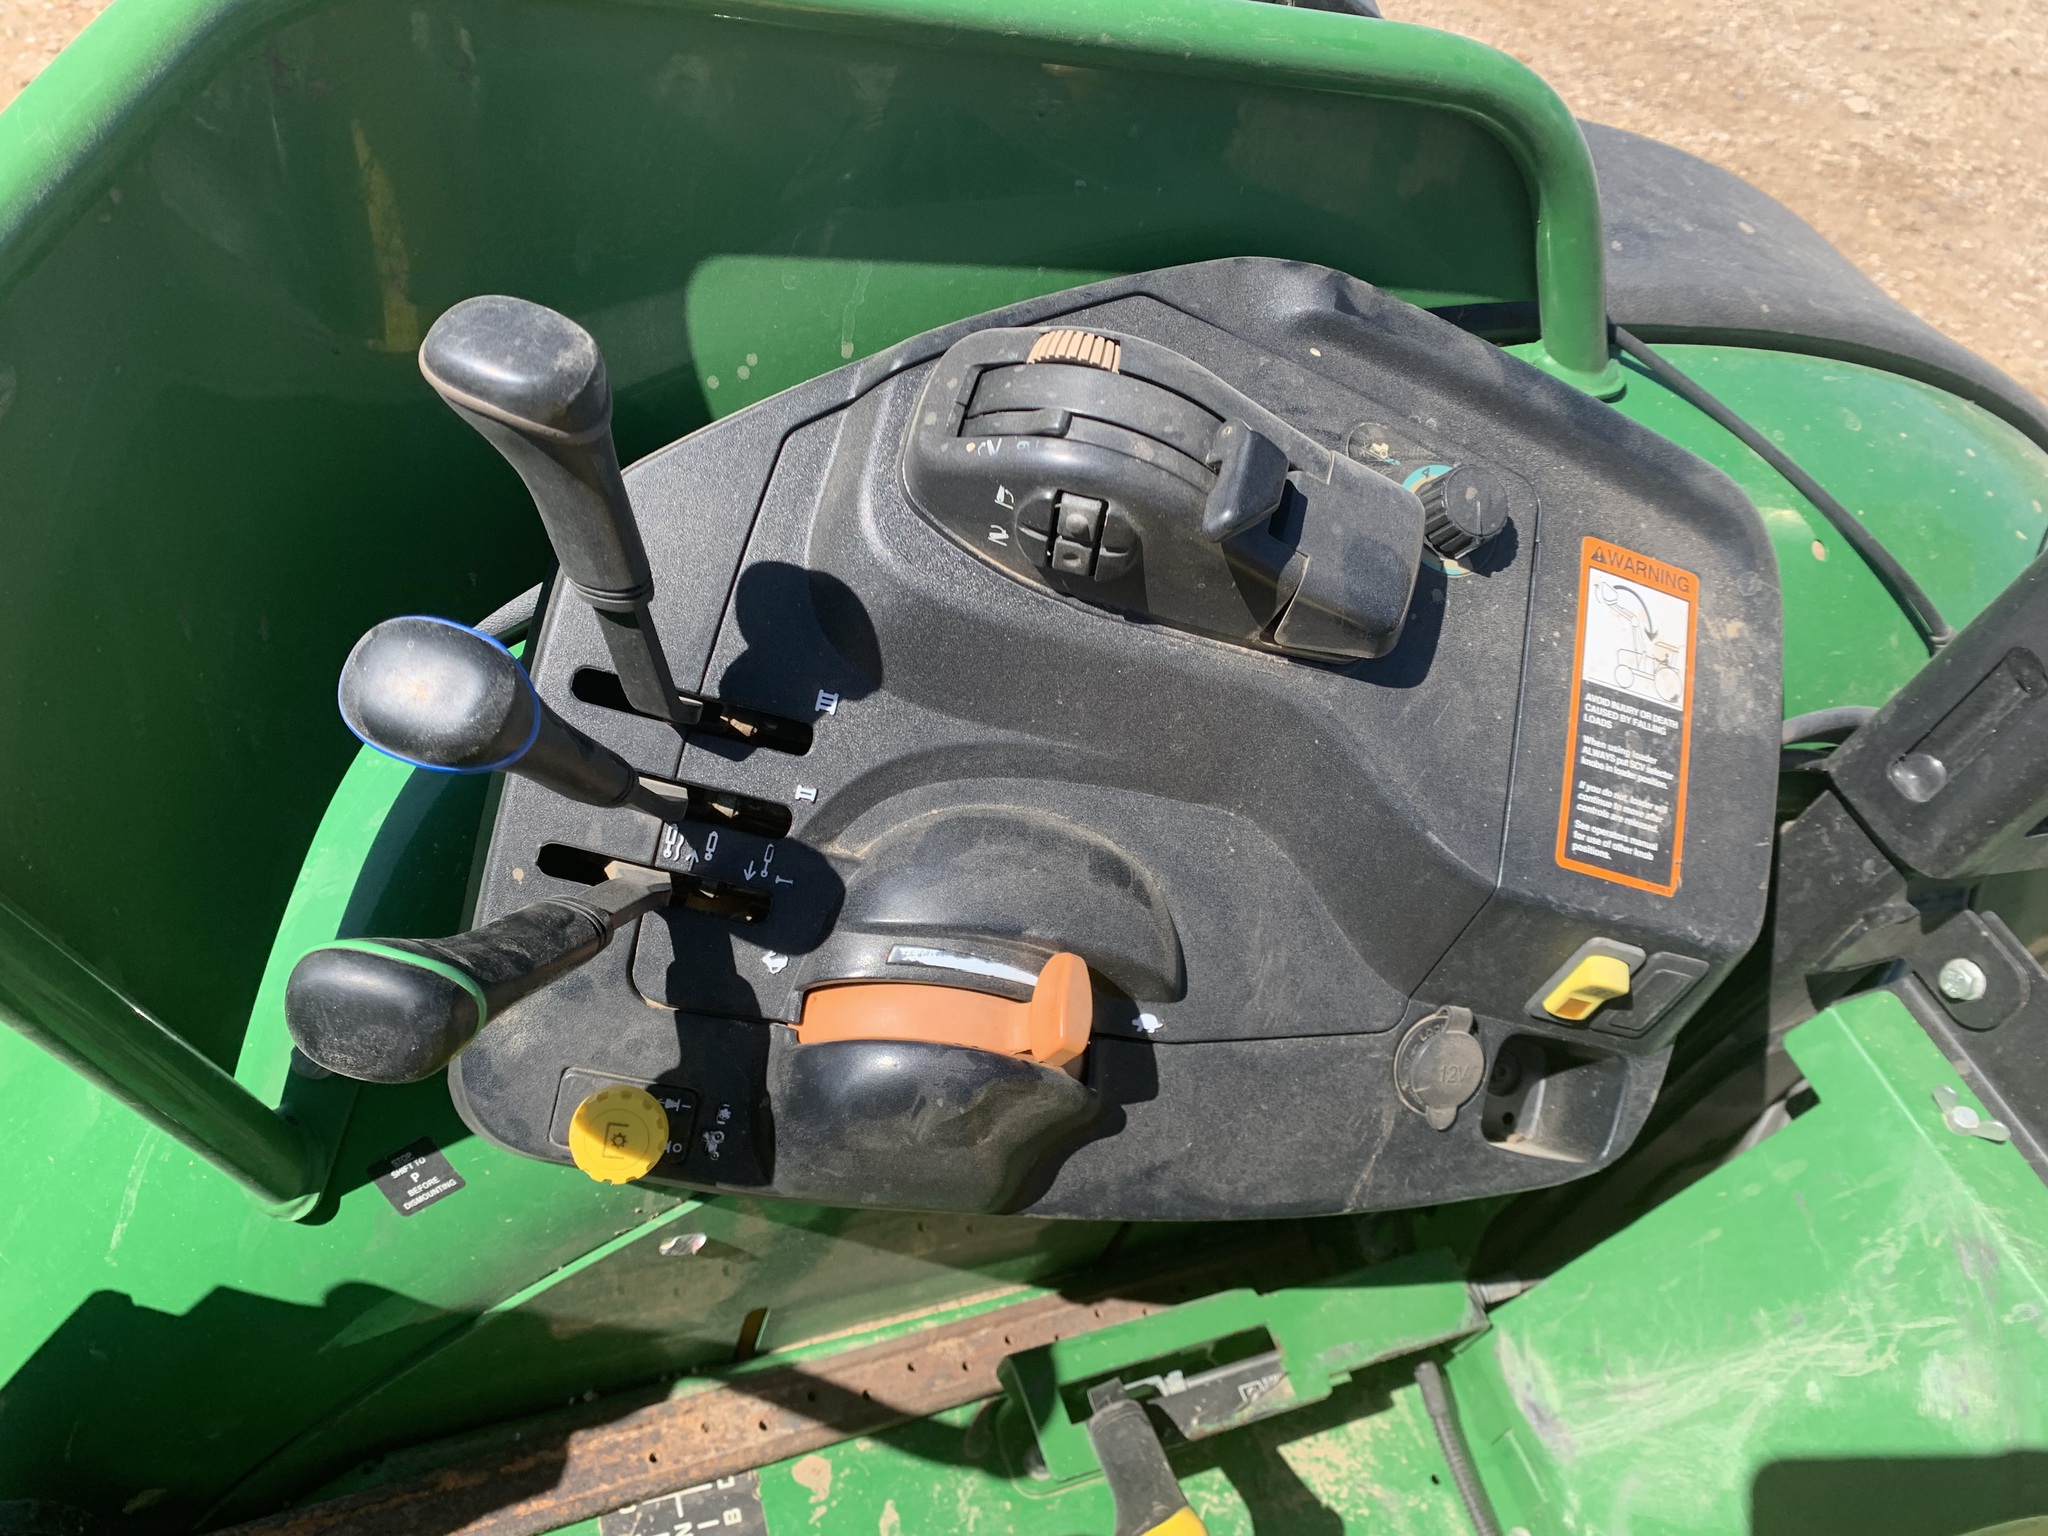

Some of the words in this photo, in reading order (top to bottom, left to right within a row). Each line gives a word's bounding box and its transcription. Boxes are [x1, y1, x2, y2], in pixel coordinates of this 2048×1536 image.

[1607, 549, 1690, 593] WARNING
[1583, 713, 1613, 729] LOADS
[1584, 703, 1619, 720] CAUSED
[1619, 714, 1632, 724] BY
[1632, 718, 1667, 735] FALLING
[1585, 693, 1610, 707] AVOID
[1611, 701, 1640, 716] INJURY
[1640, 710, 1652, 720] OR
[1652, 714, 1679, 729] DEATH
[1582, 734, 1607, 749] When
[1607, 744, 1630, 759] using
[1632, 750, 1658, 765] loader
[1582, 746, 1616, 763] ALWAYS
[1615, 756, 1629, 767] put
[1629, 760, 1646, 772] SCV
[1581, 756, 1605, 770] knobs
[1605, 763, 1613, 773] in
[1613, 766, 1637, 780] loader
[1577, 793, 1613, 808] continue
[1613, 802, 1622, 811] to
[1623, 806, 1645, 818] move
[1645, 813, 1664, 824] after
[1578, 780, 1587, 790] If
[1585, 784, 1602, 795] you
[1601, 788, 1613, 797] do
[1629, 796, 1654, 810] loader
[1654, 804, 1668, 814] will
[1576, 803, 1610, 819] controls
[1610, 814, 1624, 823] are
[1624, 817, 1659, 833] released.
[1573, 830, 1586, 841] for
[1586, 835, 1602, 846] use
[1602, 840, 1612, 848] of
[1612, 843, 1633, 855] other
[1633, 848, 1654, 861] knob
[1574, 819, 1590, 832] See
[1629, 837, 1659, 851] manual
[1572, 842, 1612, 860] positions.
[1440, 1064, 1470, 1084] 12V
[390, 1162, 414, 1179] SHIFT
[414, 1157, 426, 1167] TO
[410, 1172, 419, 1182] P
[403, 1179, 457, 1210] DISMOUNTING
[407, 1176, 440, 1197] BEFORE
[722, 1507, 742, 1527] B
